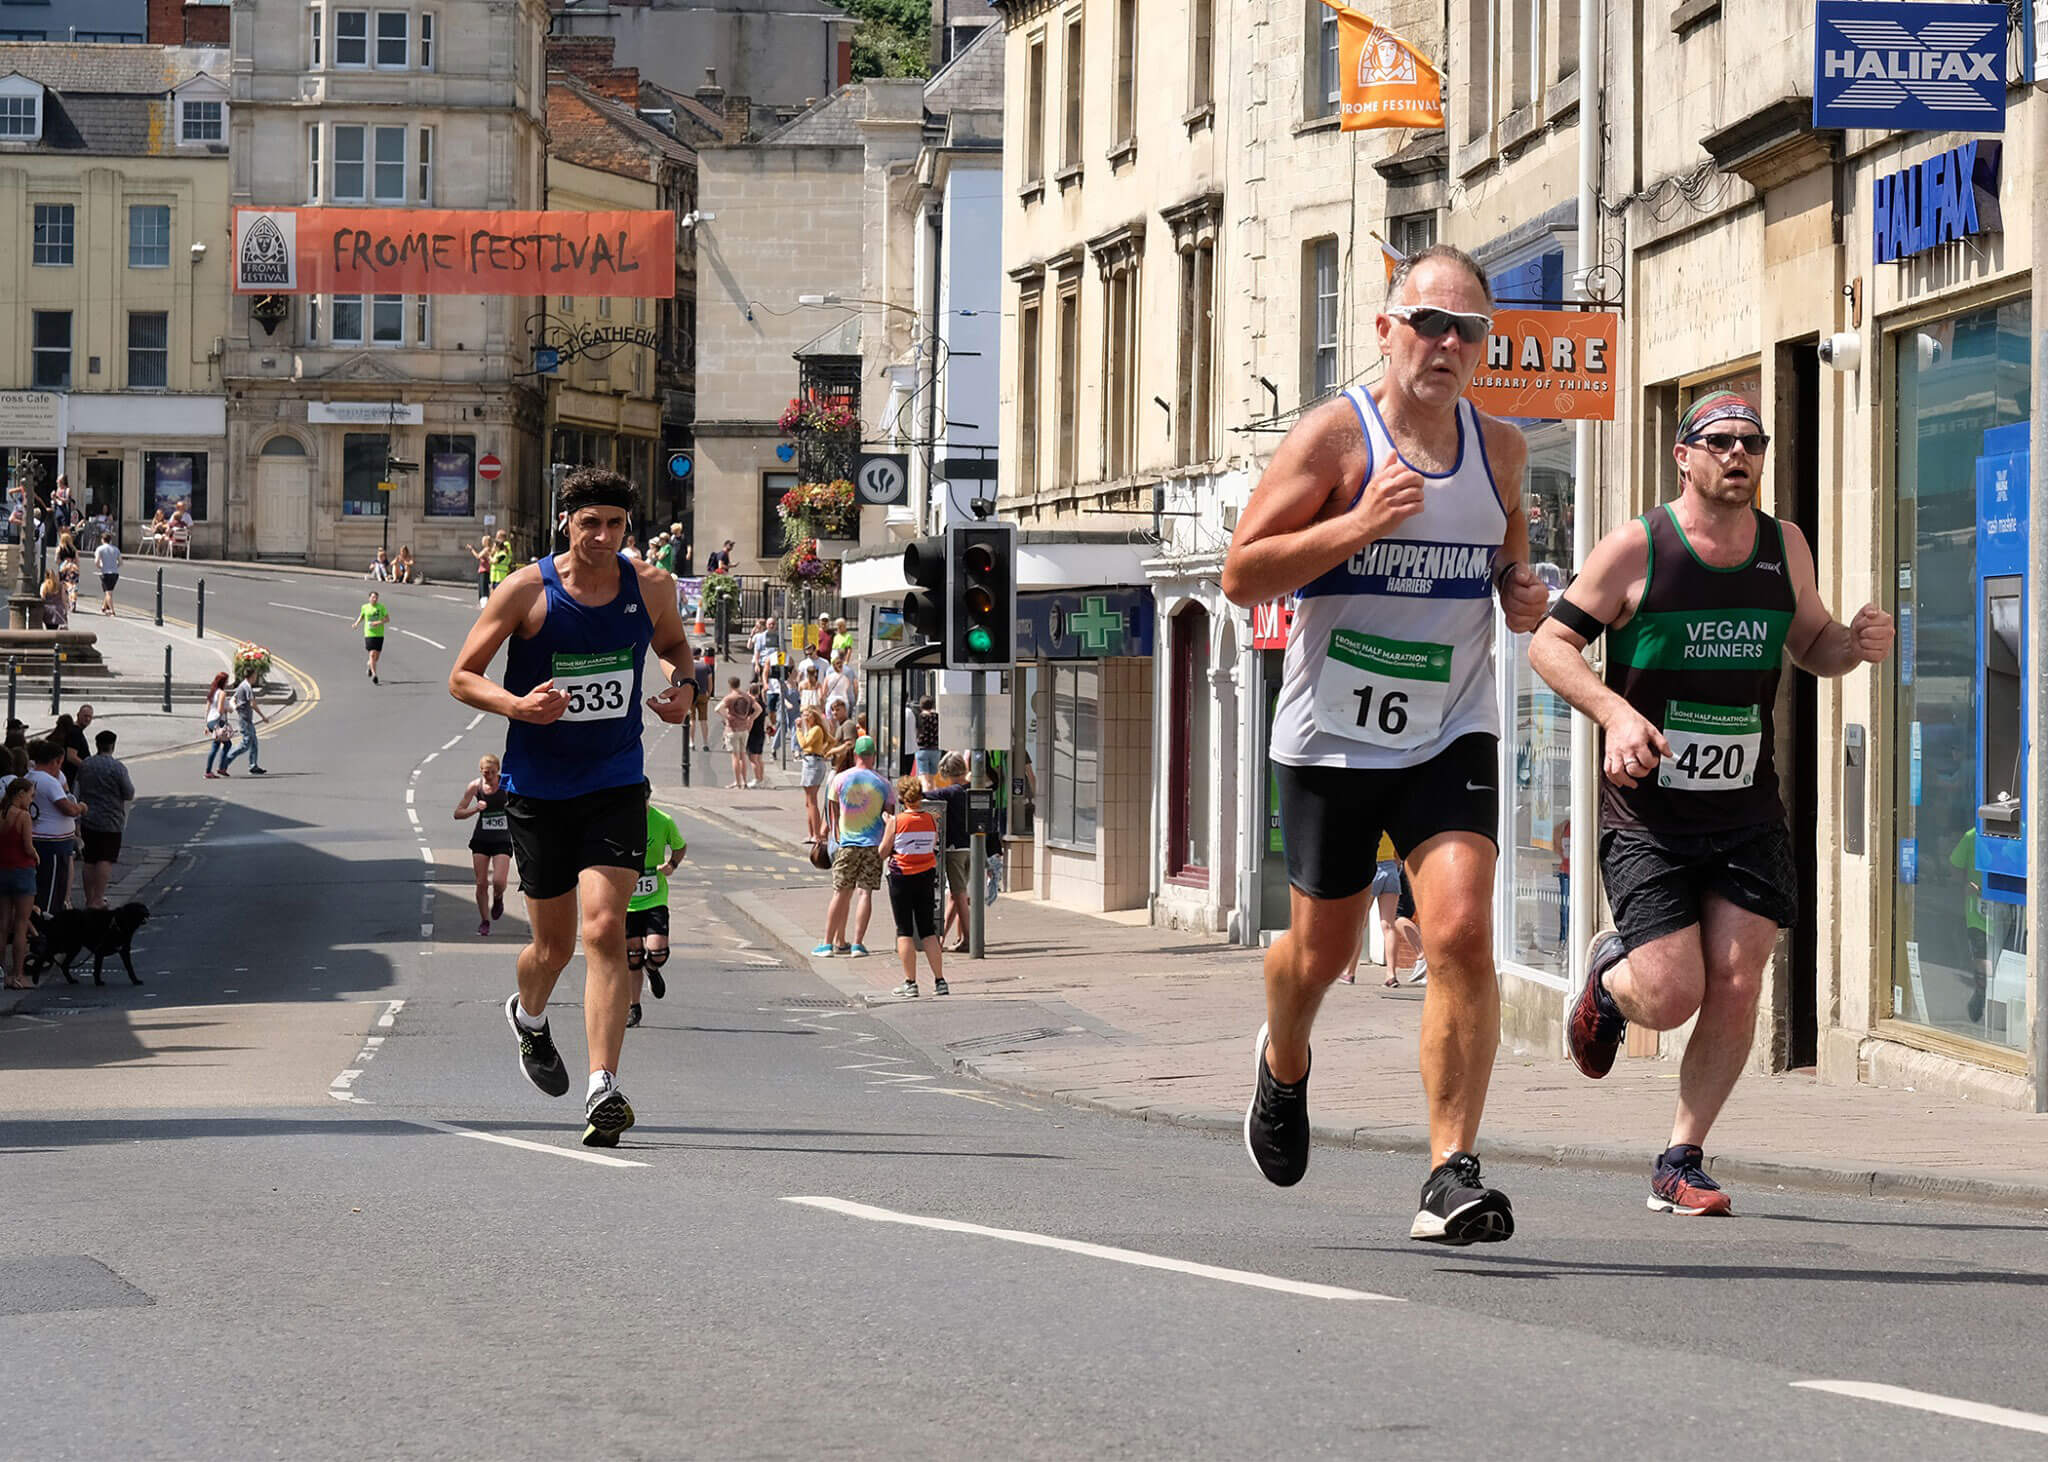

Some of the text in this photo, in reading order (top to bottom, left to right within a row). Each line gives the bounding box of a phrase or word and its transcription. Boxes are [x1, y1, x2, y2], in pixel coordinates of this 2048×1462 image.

[1824, 49, 1999, 81] HALIFAX
[1383, 99, 1440, 111] FESTIVAL
[1873, 139, 1980, 265] HALIFAX
[333, 227, 640, 275] FROME FESTIVAL
[242, 273, 287, 282] FESTIVAL
[247, 264, 282, 273] FROME
[1487, 334, 1608, 373] HARE
[1472, 376, 1609, 391] LIBRARY OF THINGS
[1, 394, 24, 403] ross
[1347, 543, 1489, 580] CHIPPENHAM
[1386, 577, 1434, 594] HARRIERS
[1686, 620, 1768, 641] VEGAN
[1335, 634, 1428, 662] FROME HALF MARATHON
[1684, 643, 1764, 659] RUNNERS
[567, 680, 624, 714] 533
[1352, 685, 1409, 735] 16
[1675, 743, 1745, 779] 420
[634, 879, 653, 893] 15
